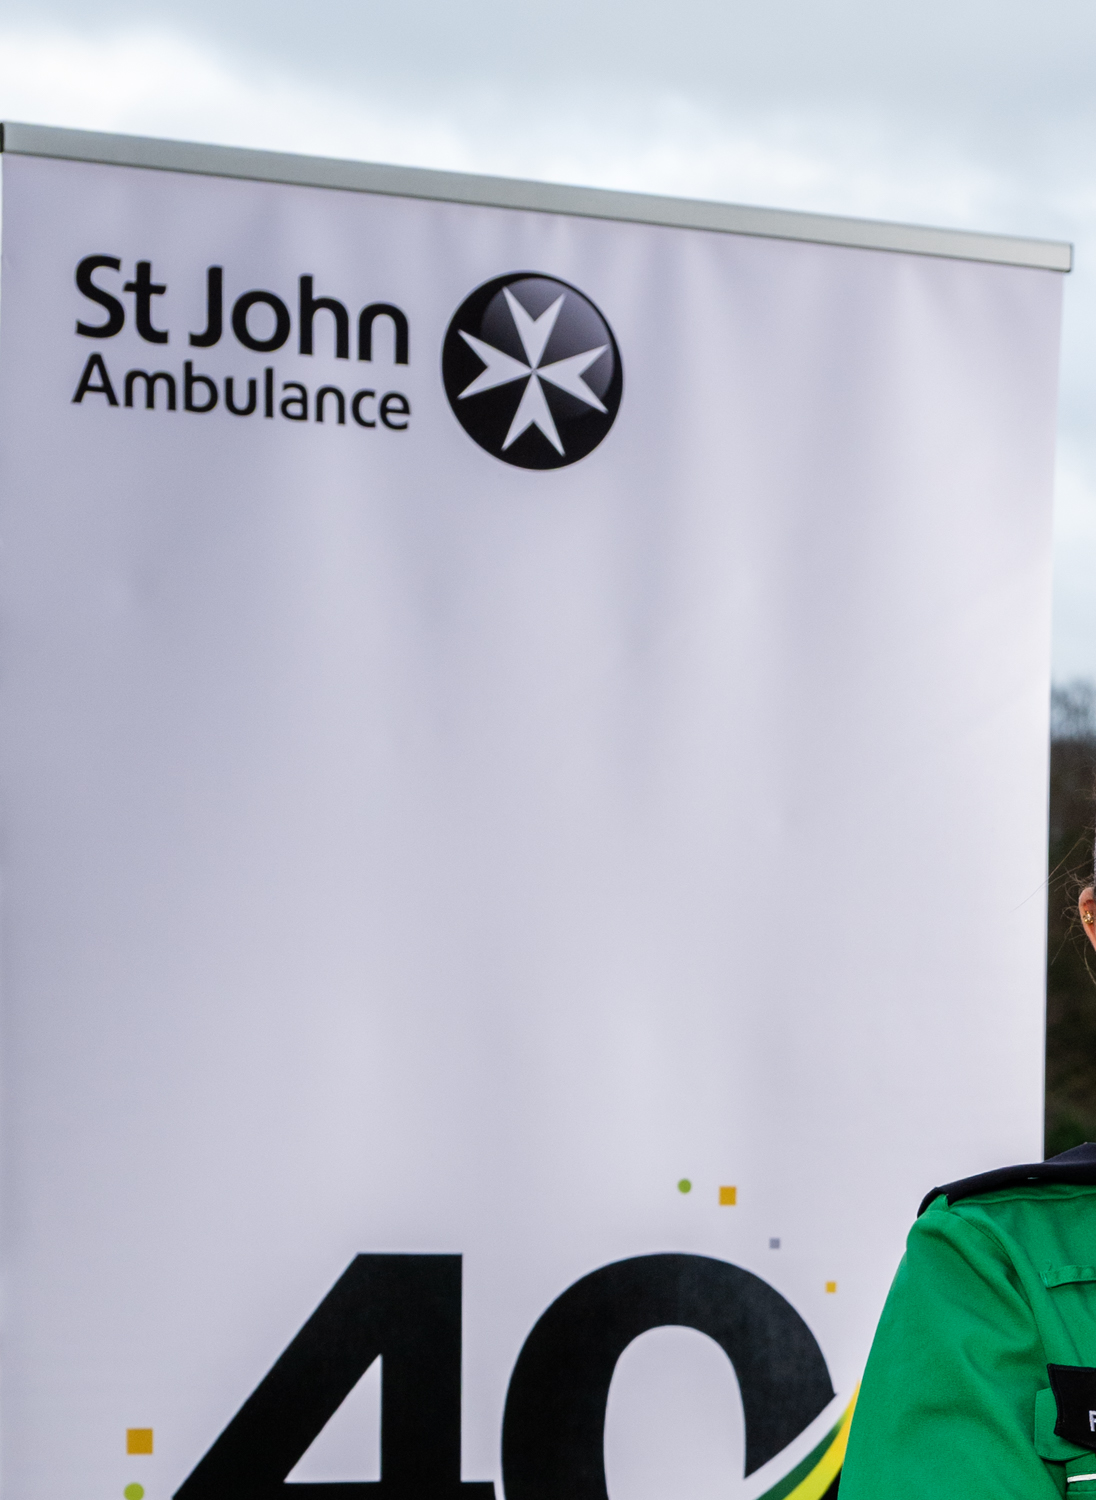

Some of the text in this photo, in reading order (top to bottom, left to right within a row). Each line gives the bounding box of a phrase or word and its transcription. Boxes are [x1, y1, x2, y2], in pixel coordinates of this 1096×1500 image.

[75, 253, 410, 365] St John
[71, 352, 411, 431] Ambulance
